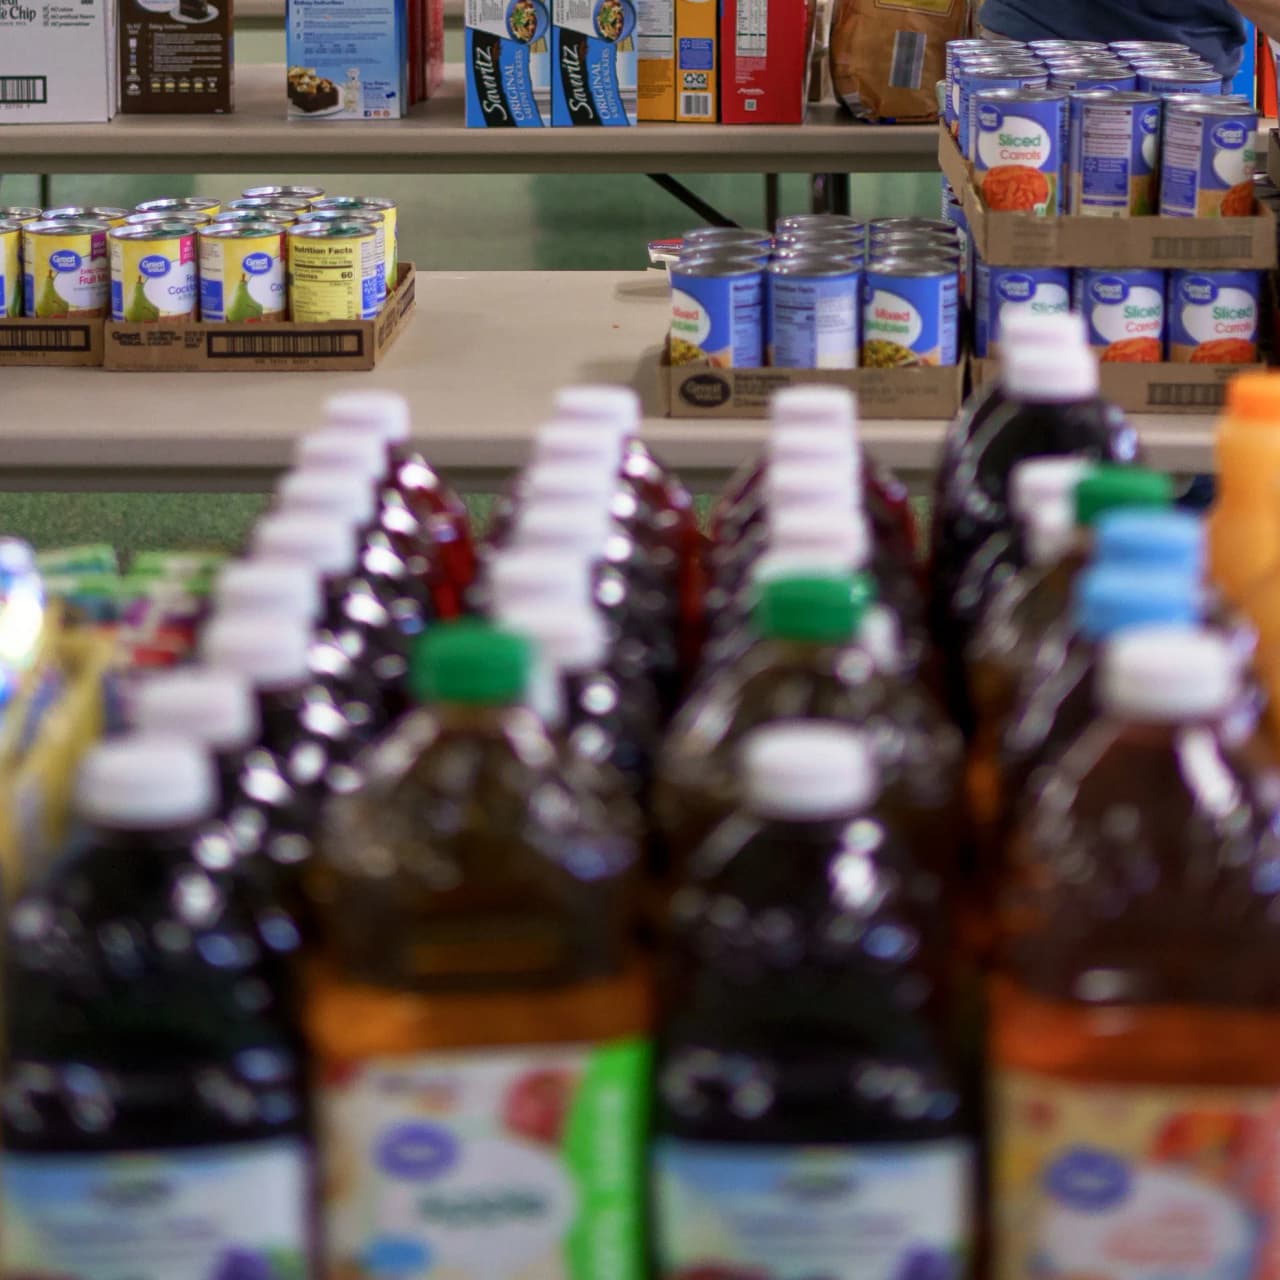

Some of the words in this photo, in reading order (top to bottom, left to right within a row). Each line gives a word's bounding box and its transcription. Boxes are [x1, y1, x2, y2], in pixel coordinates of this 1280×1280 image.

[9, 6, 36, 21] Chip
[504, 65, 525, 121] ORIGINAL
[591, 63, 611, 120] ORIGINAL
[998, 133, 1041, 146] Sliced
[1000, 150, 1041, 161] Carrots
[294, 246, 325, 255] Nutrition
[328, 247, 353, 255] Facts
[52, 255, 76, 264] Great
[142, 260, 165, 269] Great
[245, 258, 268, 267] Great
[340, 272, 353, 280] 60
[1000, 279, 1028, 290] Great
[1094, 282, 1123, 292] Great
[1184, 283, 1211, 293] Great
[1124, 305, 1161, 319] Sliced
[1212, 306, 1253, 320] Sliced
